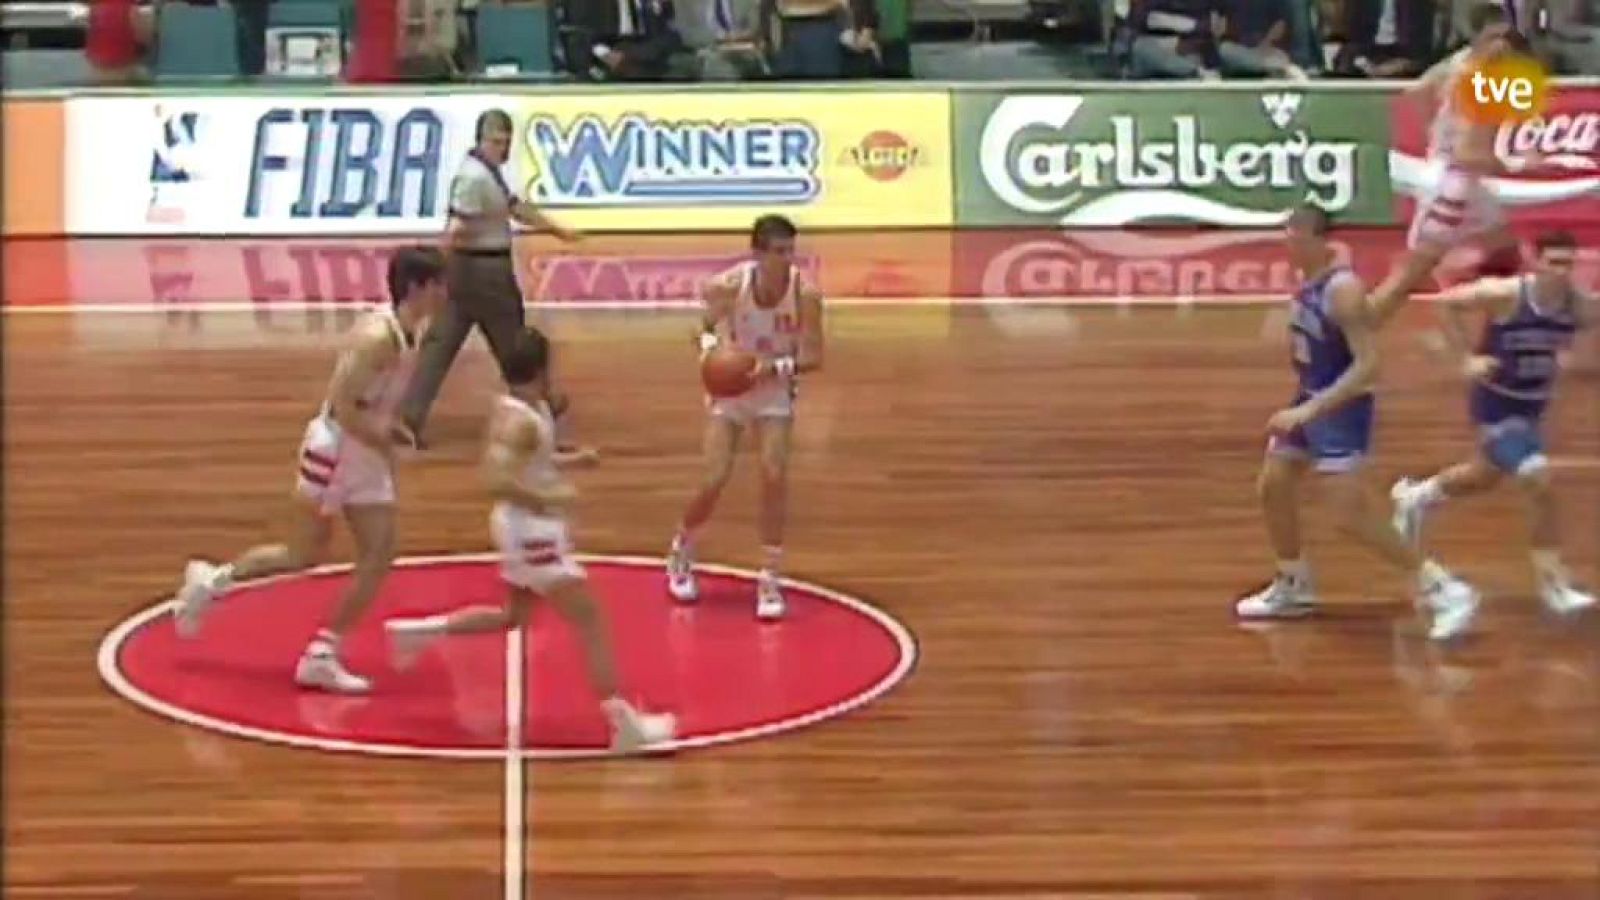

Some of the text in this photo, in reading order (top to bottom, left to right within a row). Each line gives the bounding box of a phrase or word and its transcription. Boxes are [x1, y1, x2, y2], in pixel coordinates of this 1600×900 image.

[243, 108, 443, 218] FIBA
[532, 118, 812, 195] WINNER
[980, 95, 1357, 214] Carlsberg
